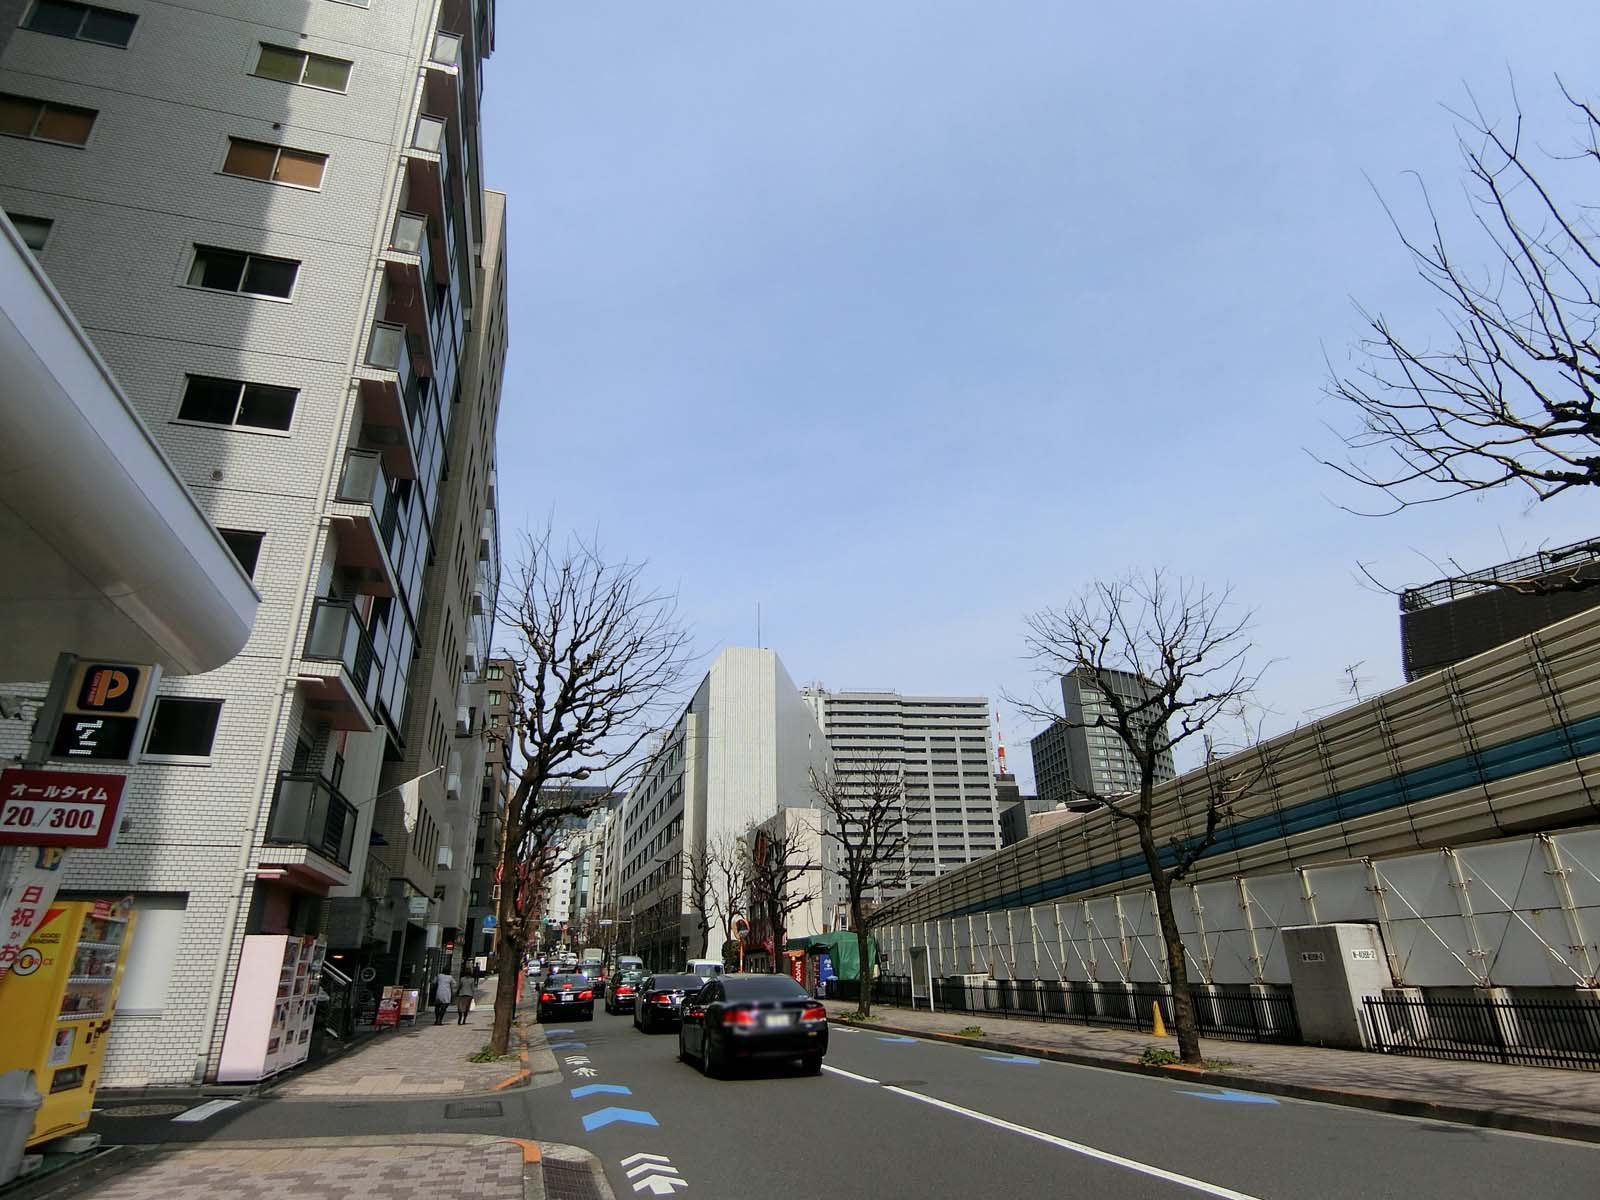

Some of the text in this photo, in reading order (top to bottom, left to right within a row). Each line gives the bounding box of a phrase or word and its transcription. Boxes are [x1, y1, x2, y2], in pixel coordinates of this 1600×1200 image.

[93, 669, 130, 706] P
[10, 783, 109, 801] オールタイム
